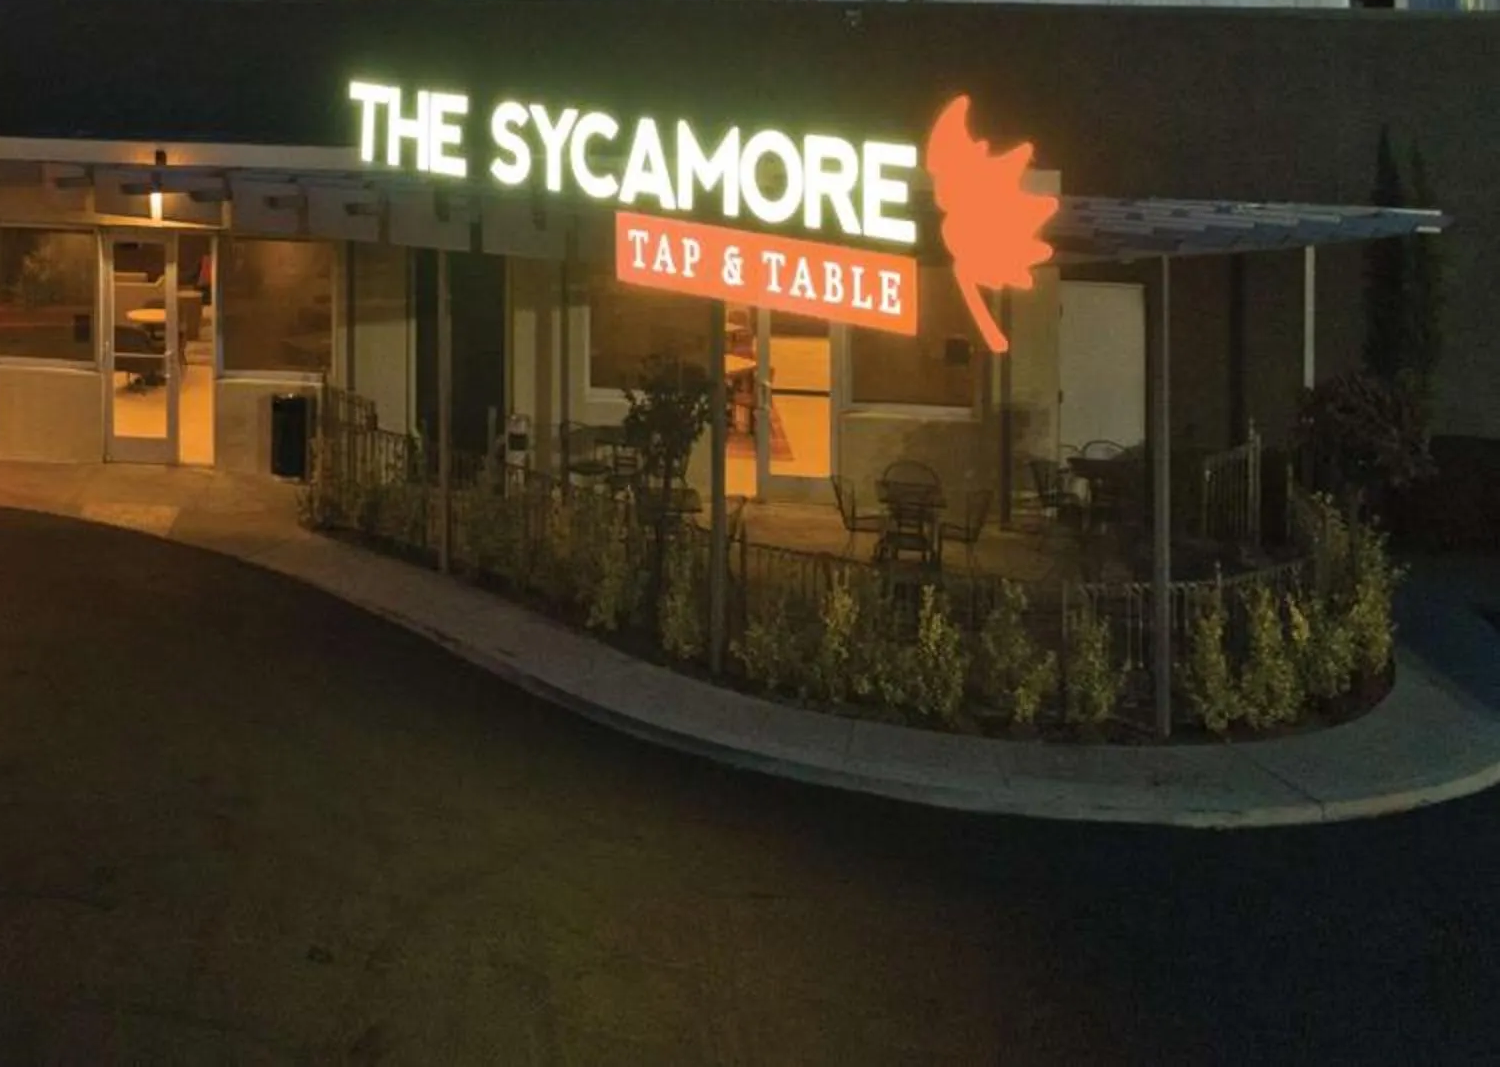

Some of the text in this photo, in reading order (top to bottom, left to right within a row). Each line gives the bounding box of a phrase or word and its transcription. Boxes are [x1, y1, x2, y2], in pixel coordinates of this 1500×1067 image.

[348, 81, 916, 242] THE SYCAMORE
[628, 229, 902, 313] TAP & TABLE
